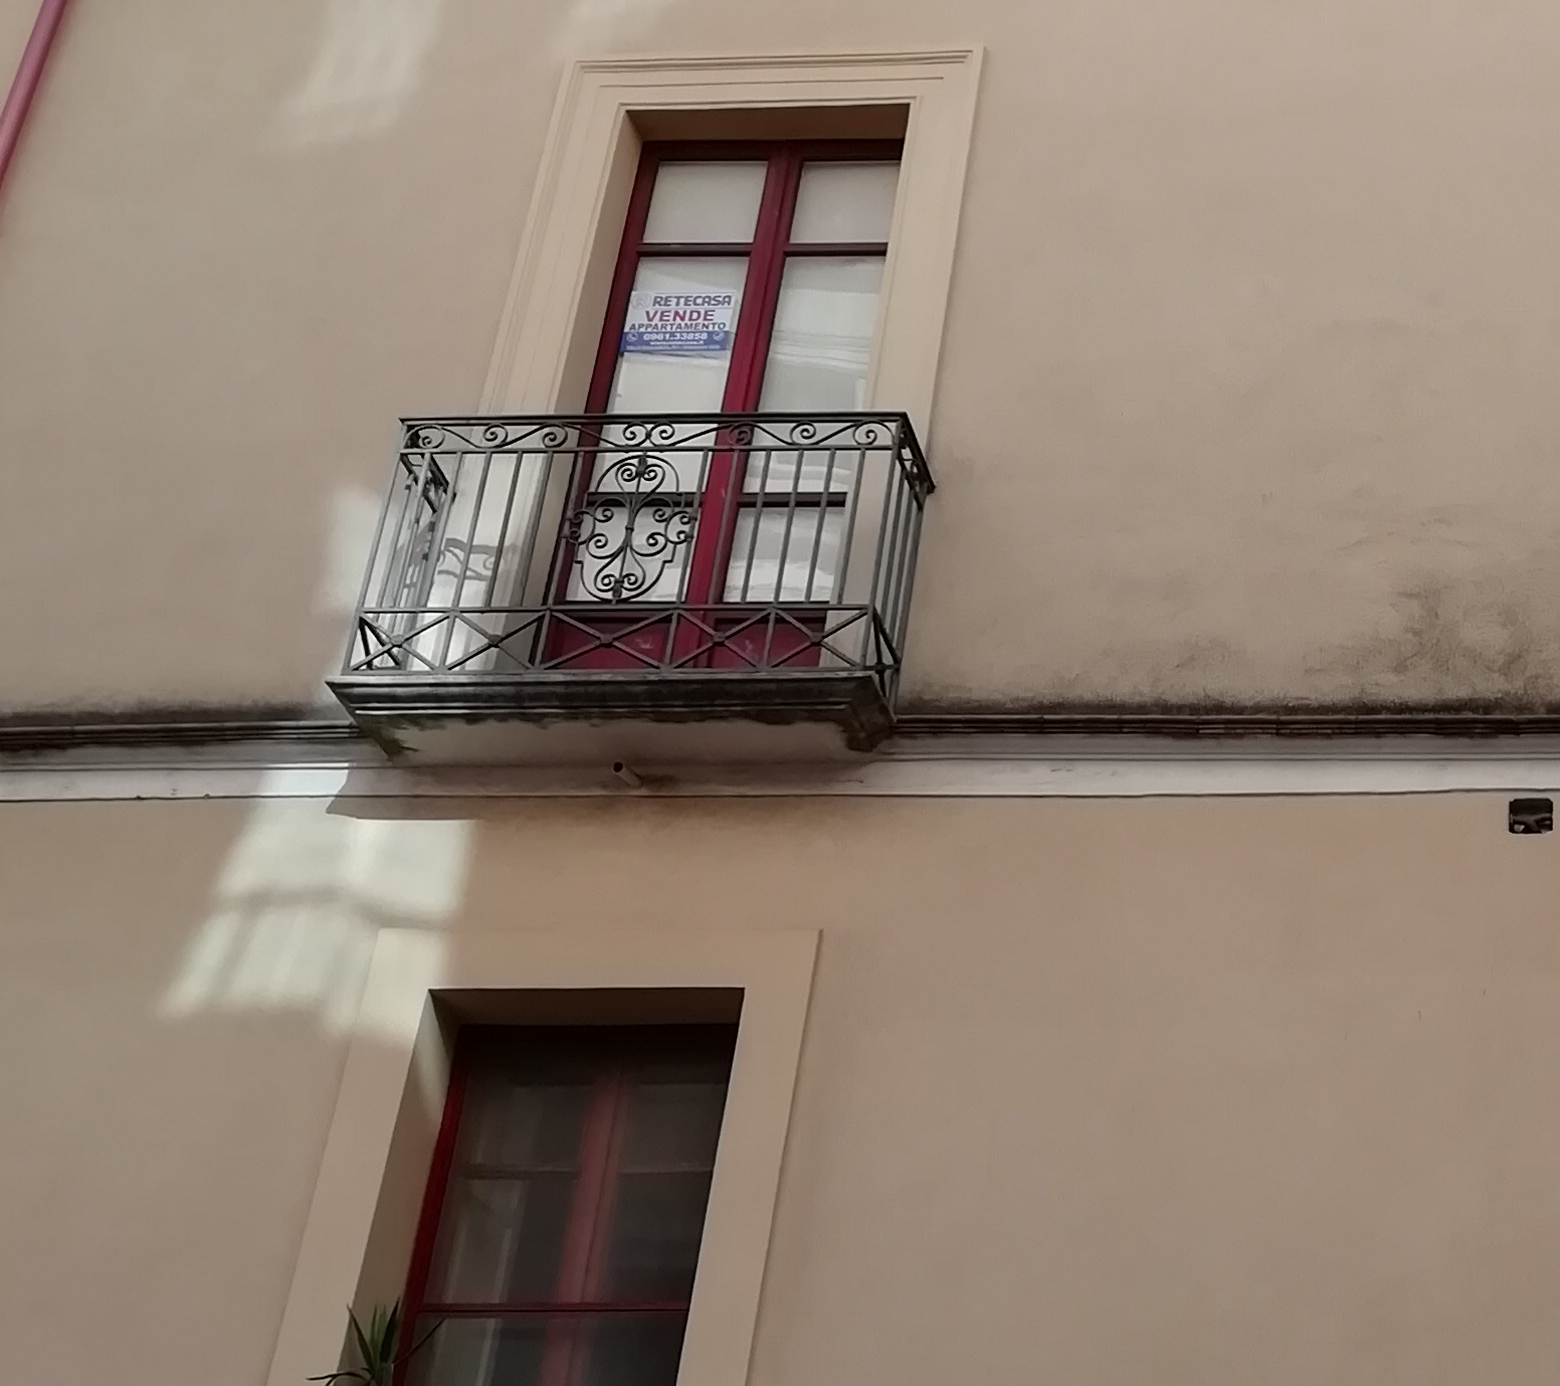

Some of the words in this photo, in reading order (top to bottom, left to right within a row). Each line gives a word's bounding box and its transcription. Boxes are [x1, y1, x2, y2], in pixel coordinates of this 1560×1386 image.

[652, 295, 732, 307] RETECASA
[645, 309, 716, 322] VENDE
[629, 322, 727, 331] APPARTAMENTO
